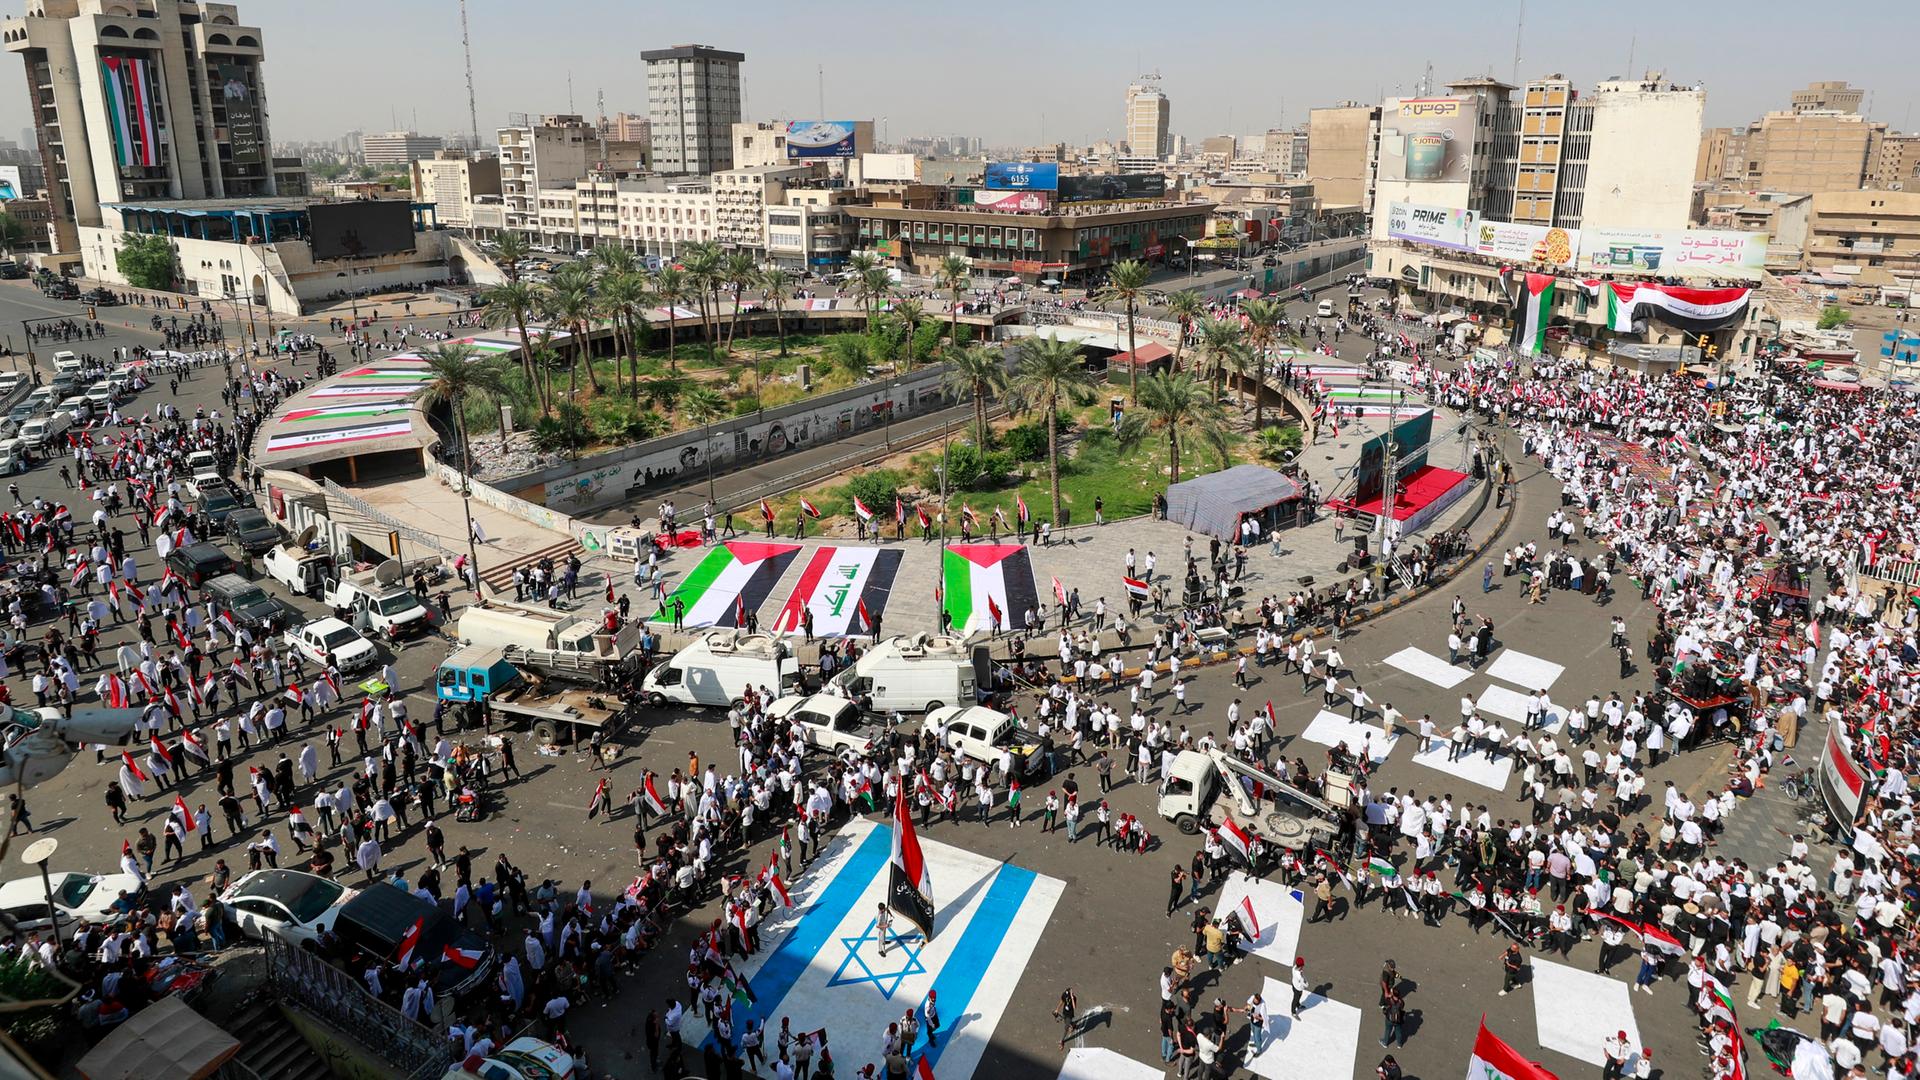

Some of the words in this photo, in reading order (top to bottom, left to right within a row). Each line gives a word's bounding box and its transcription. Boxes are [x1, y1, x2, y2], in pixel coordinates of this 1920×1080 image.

[1413, 103, 1456, 115] جوتن
[234, 138, 255, 146] طوفان
[1011, 175, 1029, 183] 6155
[1412, 209, 1447, 224] PRIME
[1680, 236, 1744, 251] الياقوت
[1676, 250, 1742, 264] المرجان
